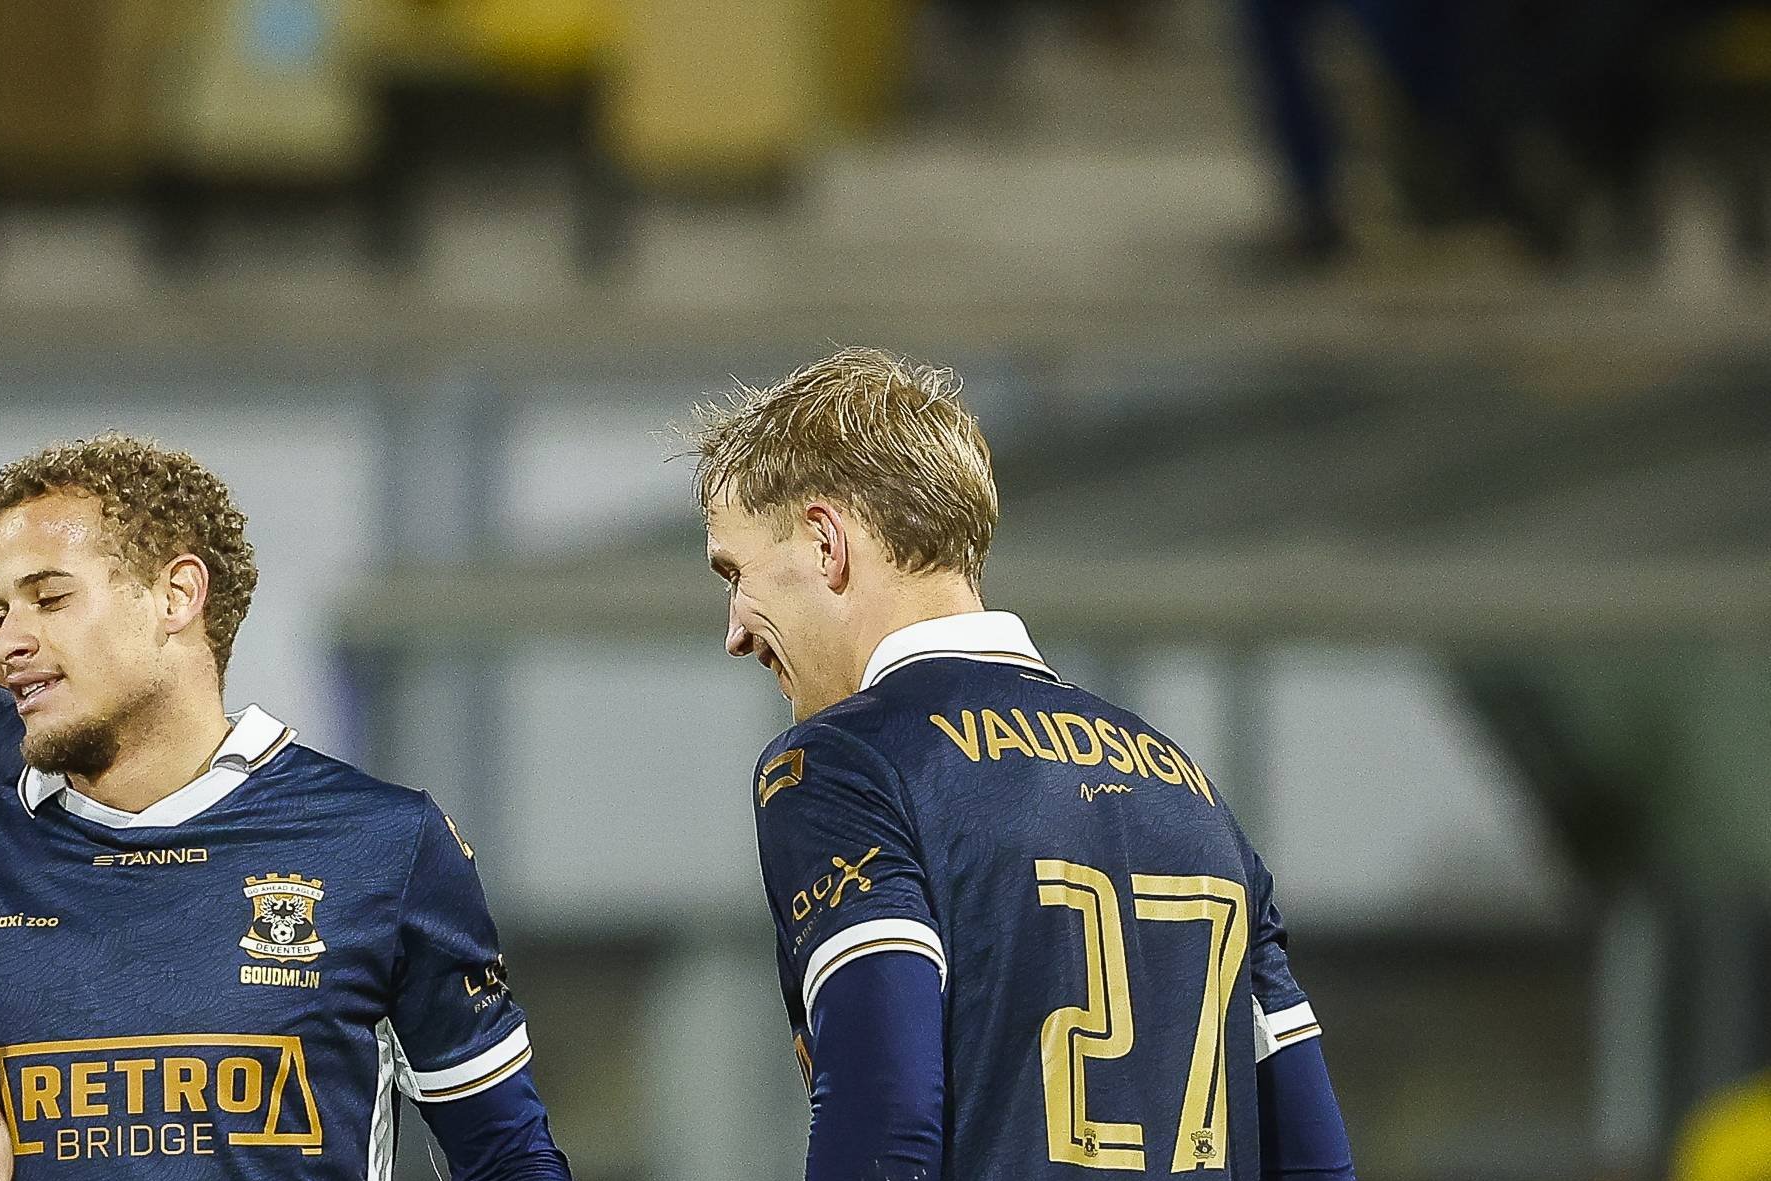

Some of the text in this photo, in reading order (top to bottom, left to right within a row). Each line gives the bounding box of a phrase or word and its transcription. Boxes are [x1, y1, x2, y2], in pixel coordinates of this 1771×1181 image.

[930, 708, 1216, 807] VALIDSIGN
[92, 848, 208, 866] STANNO
[247, 884, 321, 898] GO AHEAD EAGLES
[26, 916, 59, 928] zoo
[255, 942, 311, 954] DEVENTER
[240, 965, 320, 989] GOUDMIJN
[1034, 858, 1249, 1173] 27
[20, 1057, 263, 1121] RETRO
[57, 1122, 216, 1161] BRIDGE
